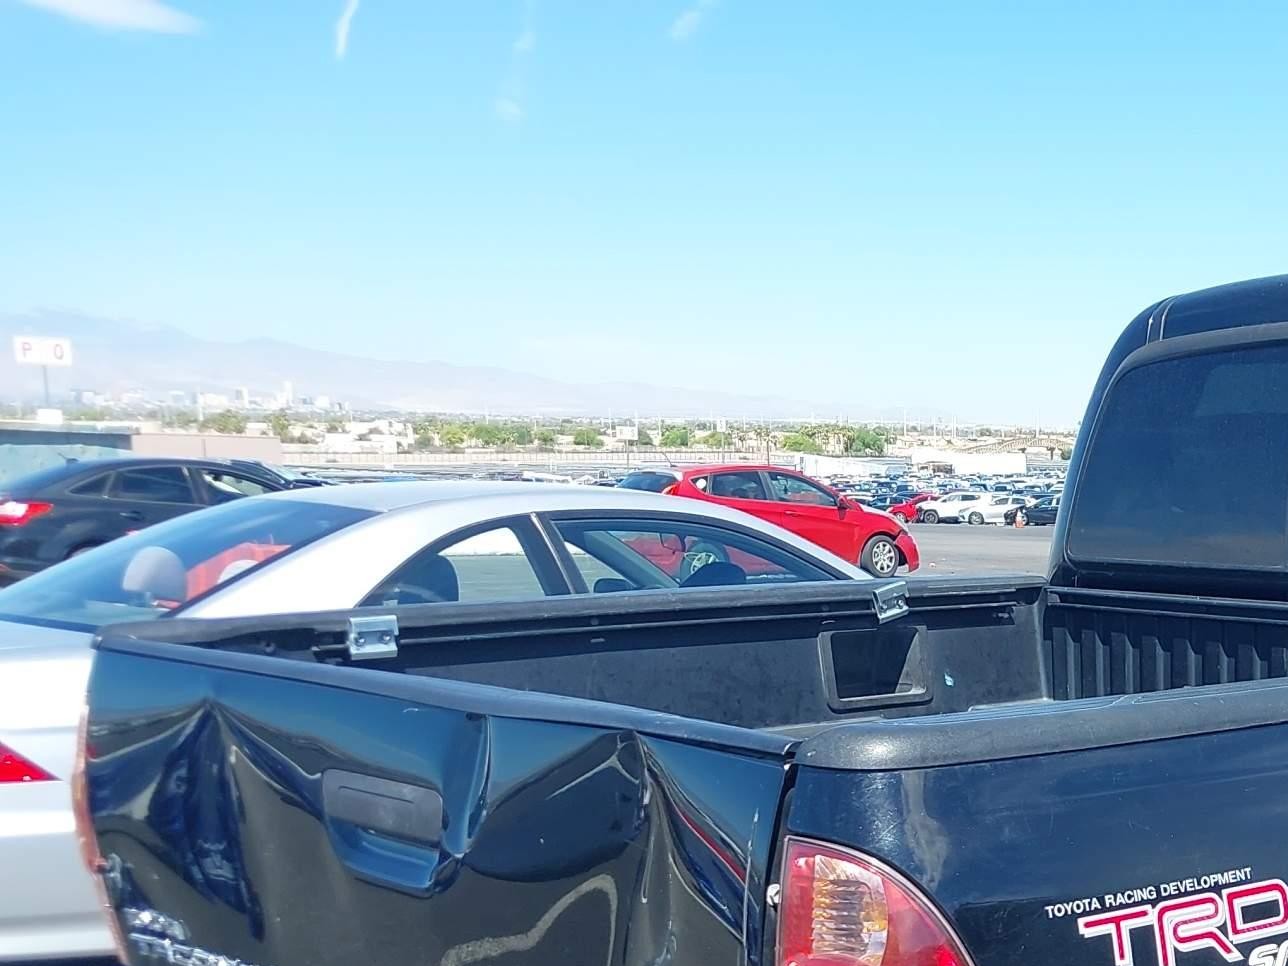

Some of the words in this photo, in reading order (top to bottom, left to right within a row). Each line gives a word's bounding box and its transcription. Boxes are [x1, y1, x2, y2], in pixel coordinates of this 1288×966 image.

[22, 341, 33, 359] P
[1044, 897, 1102, 919] TOYOTA
[1105, 887, 1157, 907] RACING
[1160, 867, 1252, 898] DEVELOPMENT
